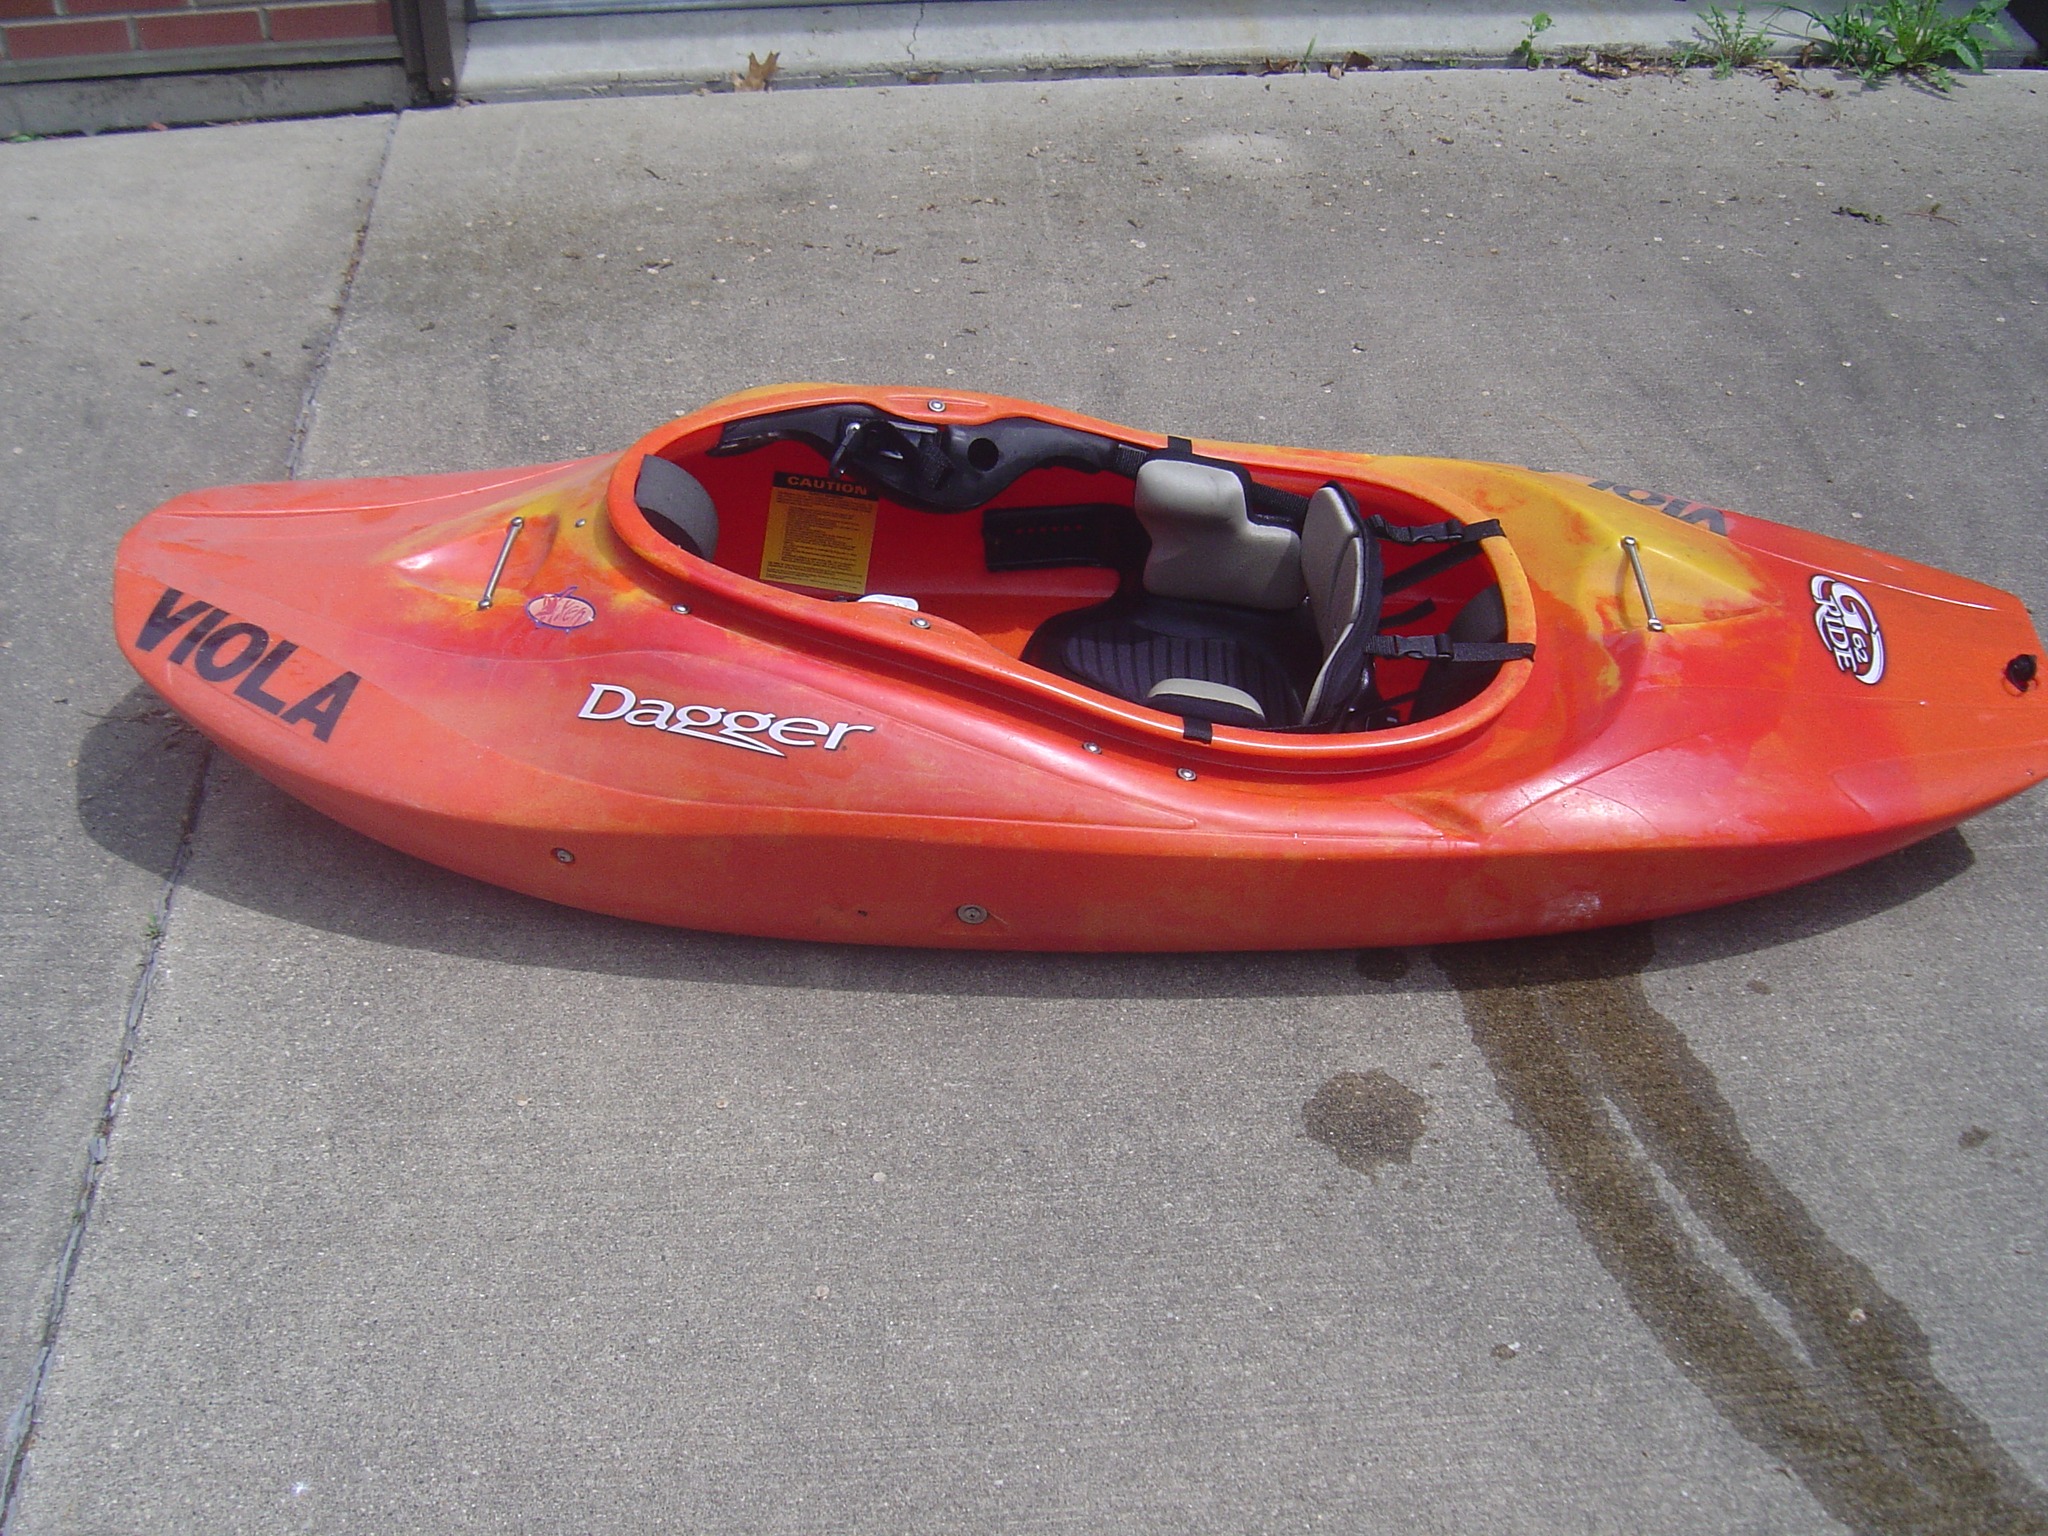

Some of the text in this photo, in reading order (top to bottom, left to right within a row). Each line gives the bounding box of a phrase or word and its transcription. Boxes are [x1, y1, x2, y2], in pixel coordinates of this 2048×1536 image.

[786, 475, 868, 496] CAUTION
[135, 587, 362, 743] VIOLA
[1814, 594, 1857, 673] RIDE
[577, 682, 875, 758] Dagger
